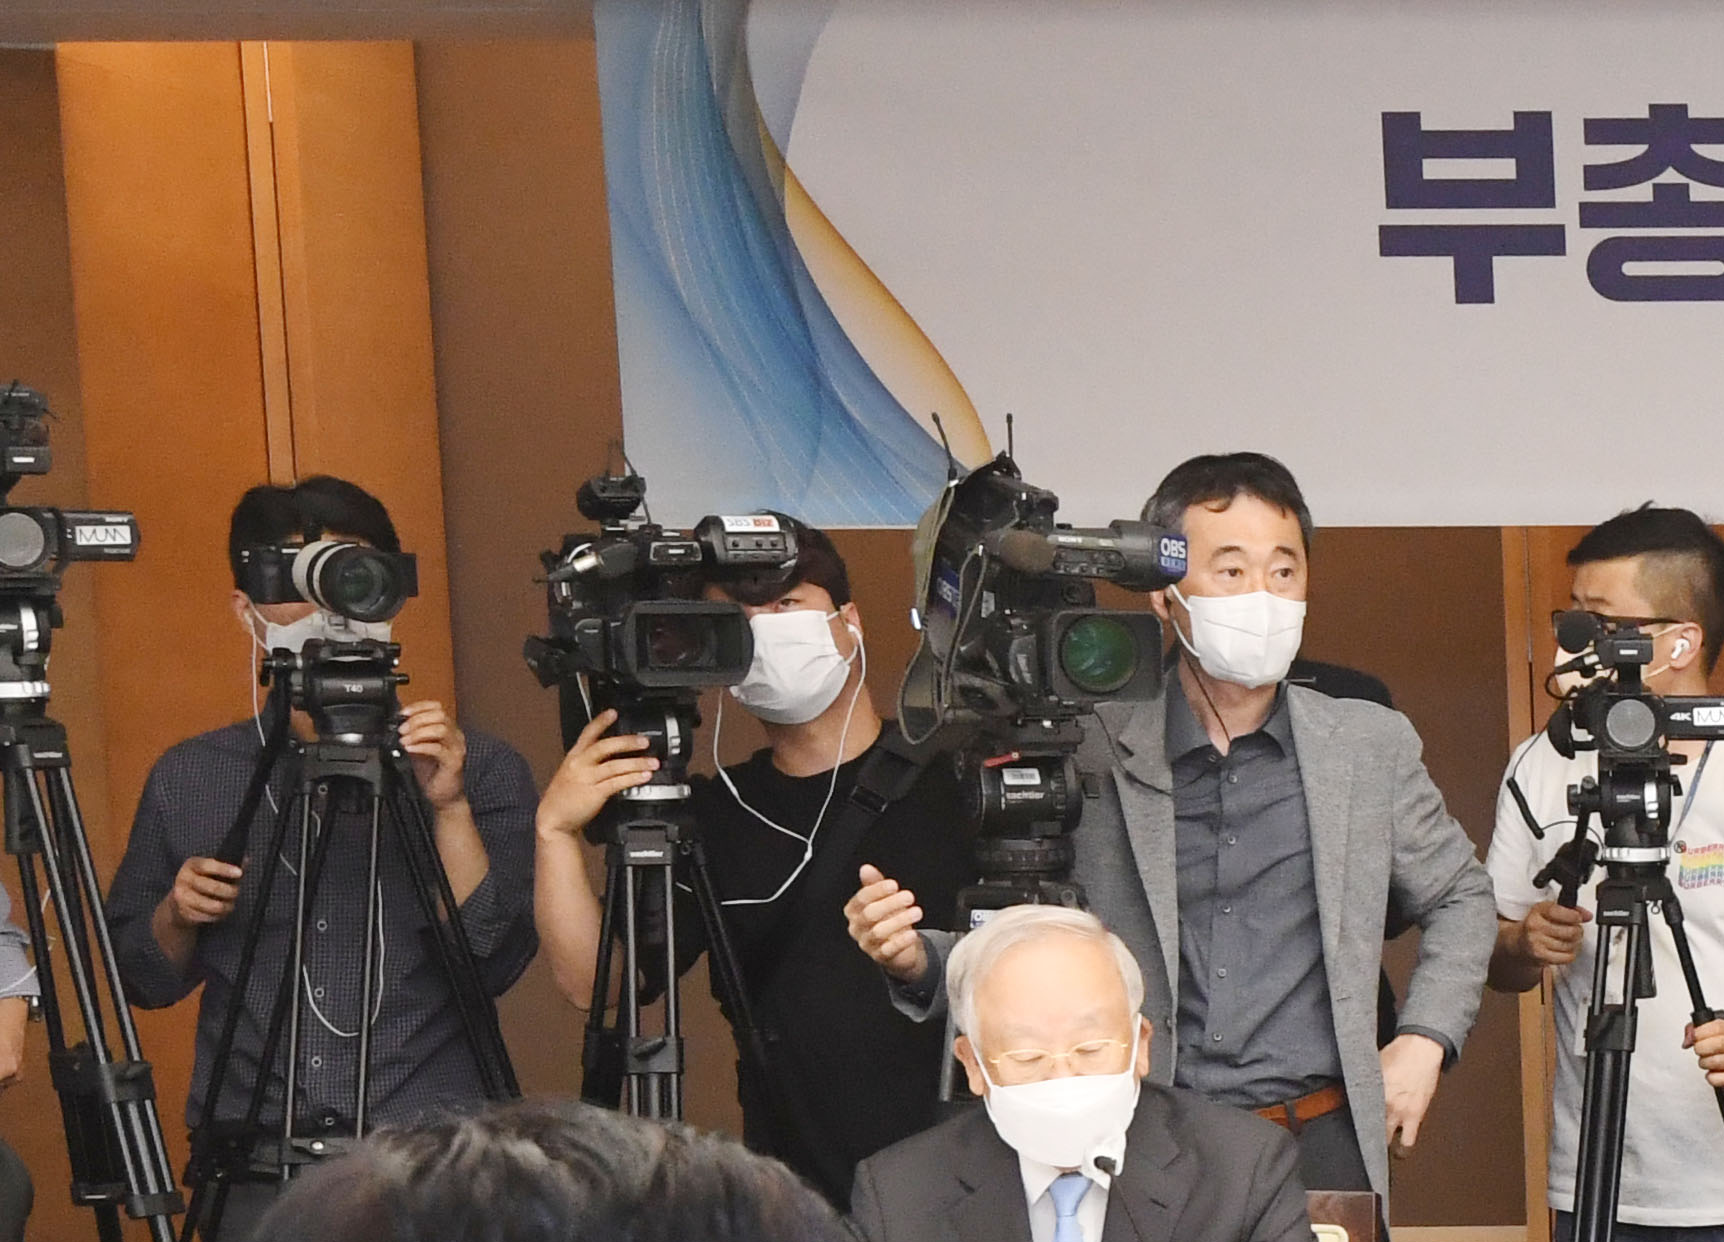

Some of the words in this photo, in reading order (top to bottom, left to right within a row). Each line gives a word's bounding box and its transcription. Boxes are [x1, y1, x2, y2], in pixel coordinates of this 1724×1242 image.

[1159, 537, 1188, 559] OBS
[344, 684, 364, 693] T40
[1669, 711, 1692, 722] 4K
